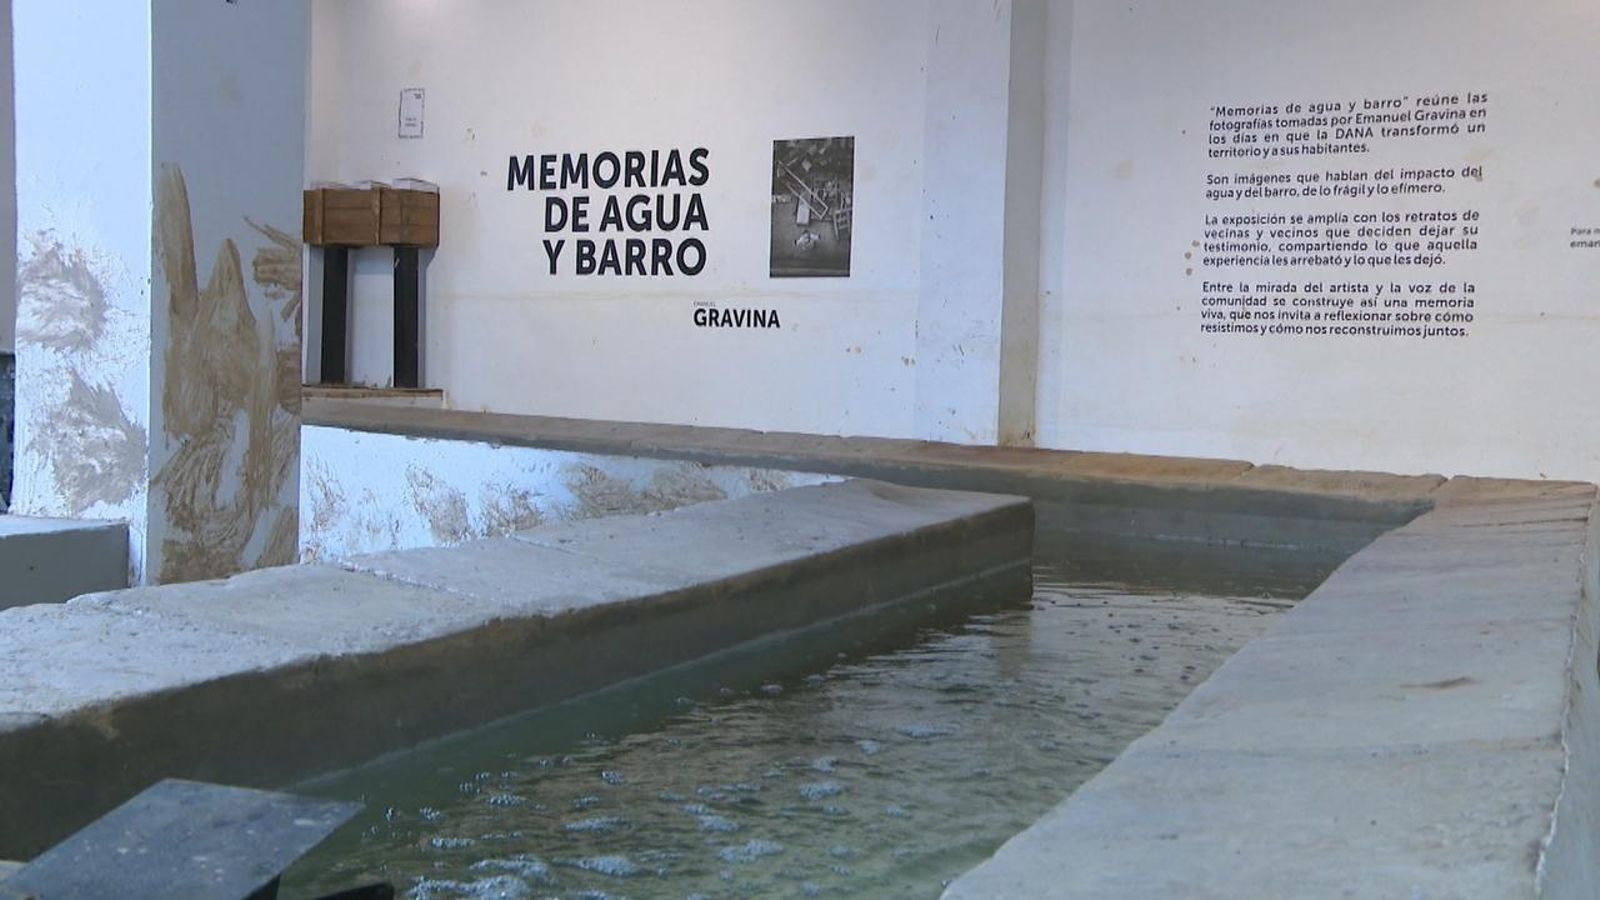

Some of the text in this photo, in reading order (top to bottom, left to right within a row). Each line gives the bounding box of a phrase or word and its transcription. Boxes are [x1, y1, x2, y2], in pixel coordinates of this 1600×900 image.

[1286, 103, 1301, 114] de
[1308, 102, 1340, 114] agua
[1349, 101, 1356, 112] y
[1416, 94, 1458, 106] reúne
[1467, 92, 1488, 104] las
[1210, 108, 1486, 132] fotografías tomadas por Emanuel Gravina en
[1209, 124, 1486, 144] los días en que la DANA transformó un
[1208, 144, 1370, 159] territorio y a sus habitantes.
[507, 148, 710, 191] MEMORIAS
[1207, 166, 1482, 186] Son imágenes que hablan del impacto del
[1206, 189, 1234, 200] agua
[1236, 190, 1242, 200] y
[1244, 187, 1262, 198] del
[1302, 186, 1316, 196] de
[1320, 186, 1330, 196] lo
[1334, 184, 1365, 198] frágil
[1367, 186, 1374, 198] y
[1376, 184, 1388, 194] lo
[544, 194, 709, 232] DE AGUA
[1206, 214, 1218, 225] La
[1222, 213, 1286, 226] exposición
[1290, 215, 1303, 224] se
[1354, 214, 1376, 222] con
[1382, 212, 1400, 222] los
[1406, 211, 1458, 222] retratos
[1462, 210, 1480, 221] de
[1204, 225, 1478, 240] vecinas y vecinos que deciden dejar su
[1204, 239, 1477, 254] testimonio, compartiendo lo que aquella
[542, 238, 706, 276] Y BARRO
[1203, 253, 1446, 268] experiencia les arrebató y lo que les dejó.
[1203, 282, 1475, 296] Entre la mirada del artista y la voz de la
[1202, 296, 1266, 306] comunidad
[1273, 298, 1286, 306] se
[1292, 297, 1354, 309] construye
[1384, 299, 1408, 308] una
[1415, 296, 1474, 308] memoria
[694, 308, 780, 328] GRAVINA
[1230, 310, 1251, 321] que
[1254, 310, 1275, 320] nos
[1278, 310, 1310, 320] invita
[1314, 312, 1320, 320] a
[1324, 310, 1392, 320] reflexionar
[1395, 311, 1432, 321] sobre
[1435, 312, 1474, 322] cómo
[1200, 322, 1469, 339] resistimos y cómo nos reconstruimos juntos.
